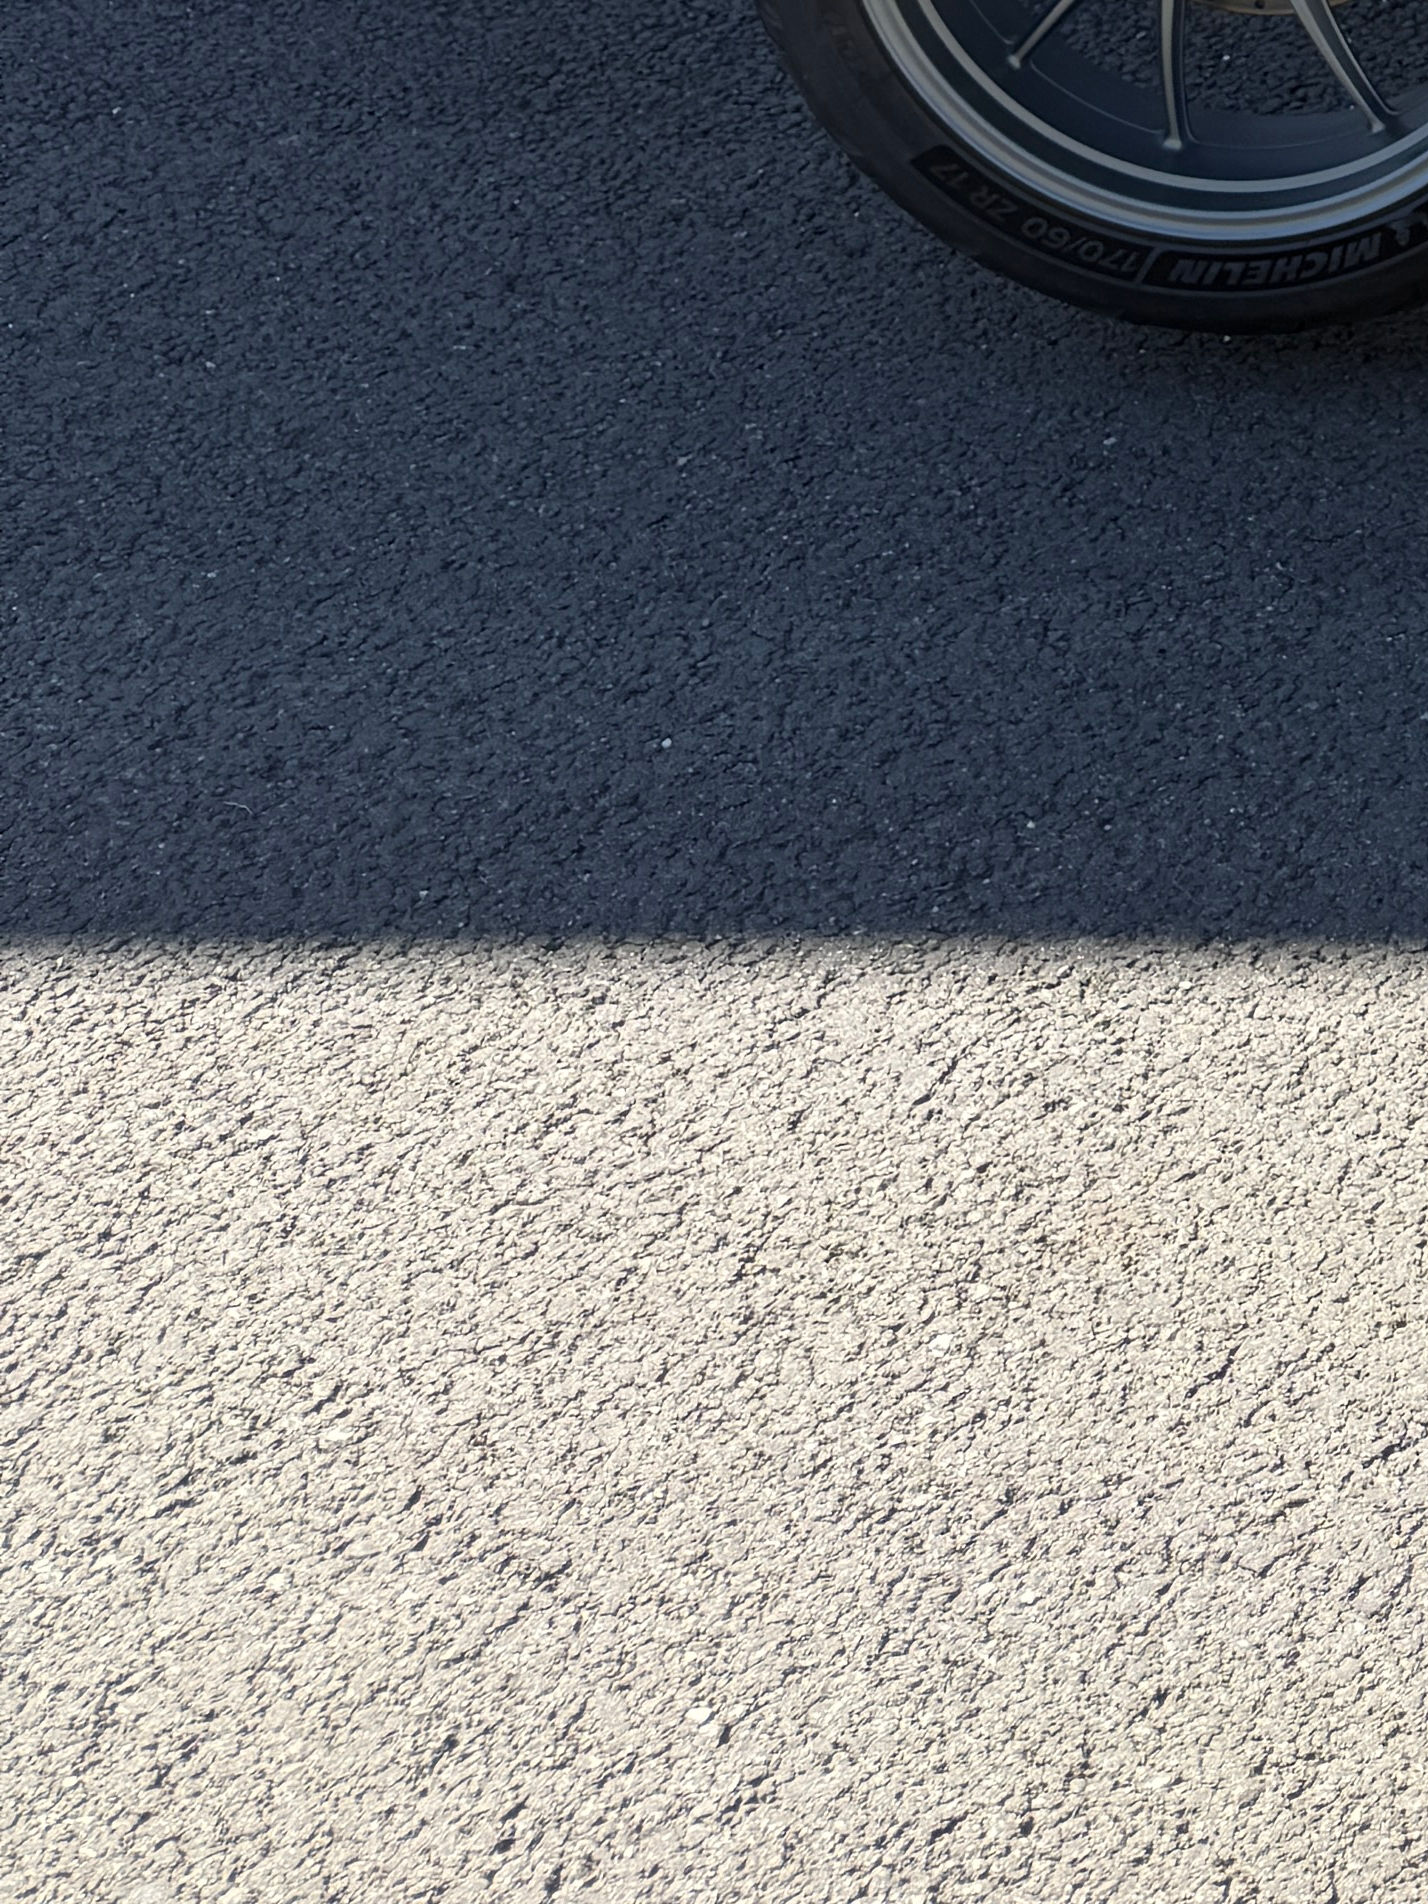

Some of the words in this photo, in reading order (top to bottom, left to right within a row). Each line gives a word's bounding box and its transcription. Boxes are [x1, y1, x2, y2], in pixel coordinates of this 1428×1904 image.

[930, 163, 968, 186] 17
[969, 185, 1019, 222] ZR
[1021, 216, 1141, 272] 170/60
[1169, 232, 1383, 286] MICHELIN
